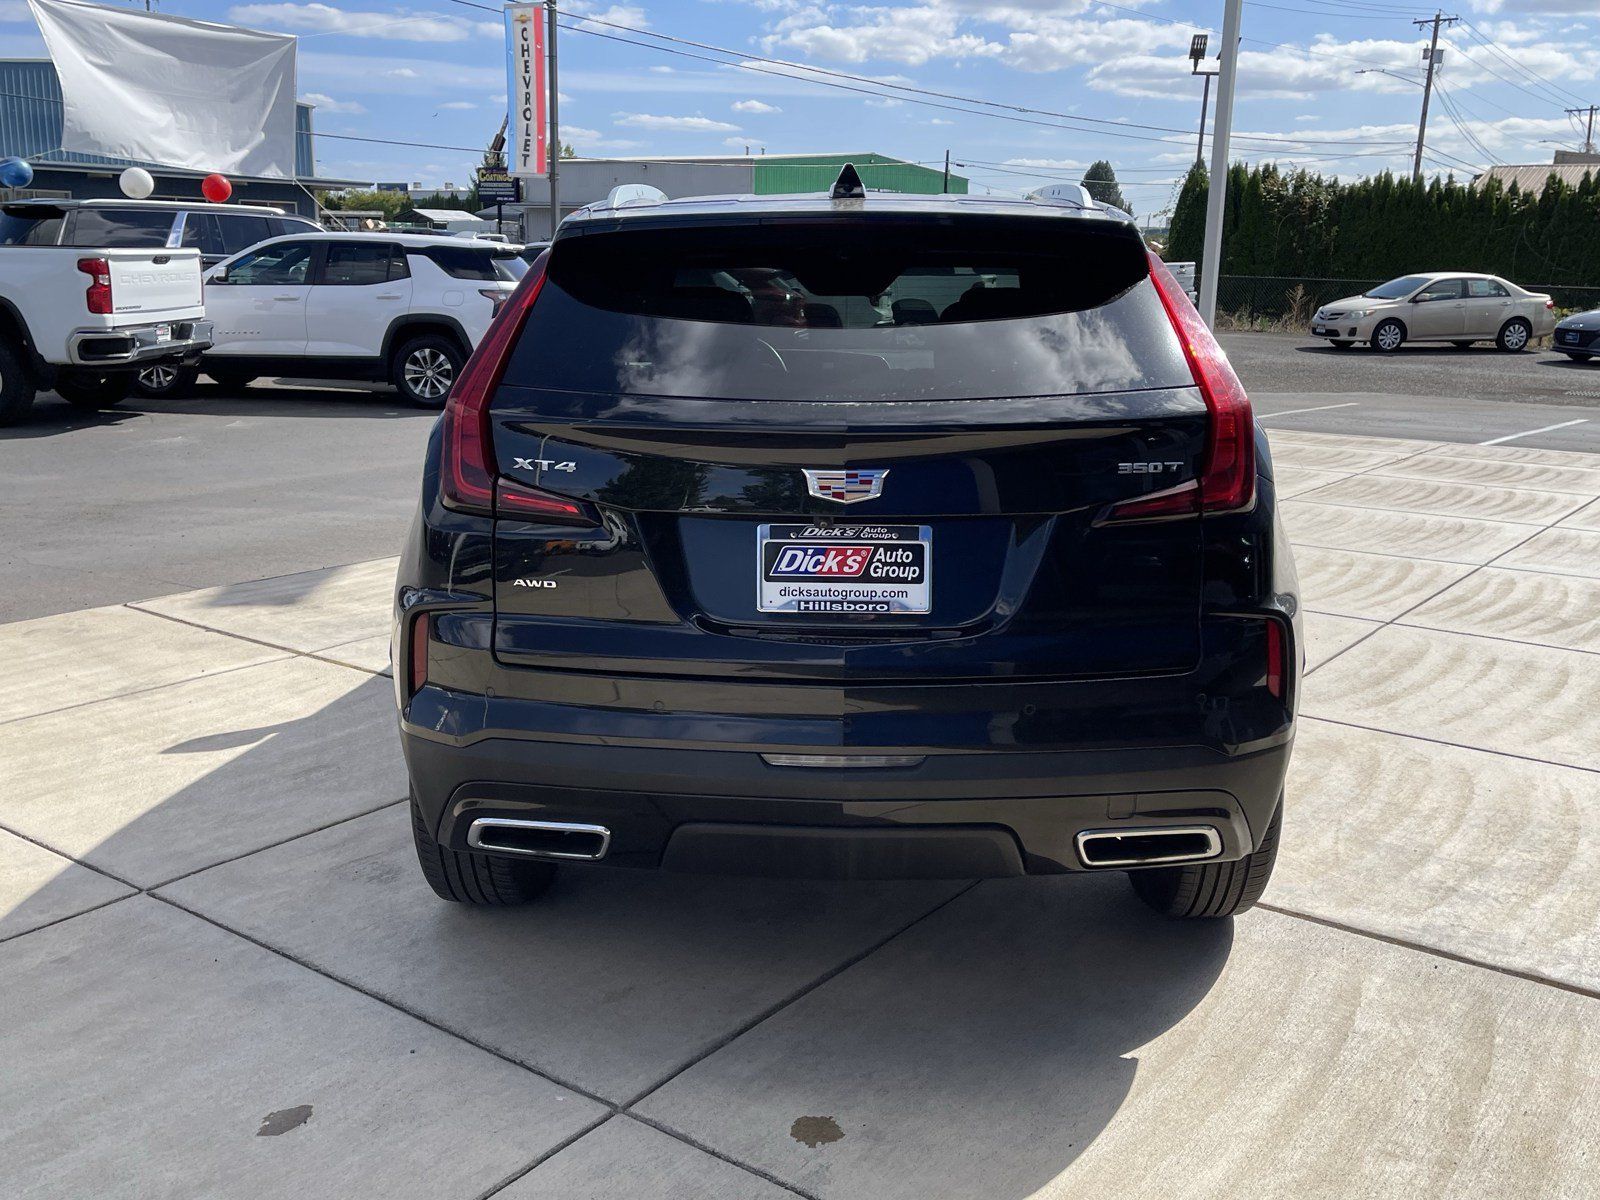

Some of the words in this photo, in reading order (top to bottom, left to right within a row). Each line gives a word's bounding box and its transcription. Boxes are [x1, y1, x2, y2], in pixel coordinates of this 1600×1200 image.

[521, 27, 532, 167] CHEVROLET
[120, 272, 197, 286] CHEVROLET
[513, 457, 577, 473] XT4
[1118, 462, 1184, 474] 350T
[803, 526, 857, 537] Dick's
[860, 532, 892, 540] Group
[780, 549, 862, 573] Dick's
[873, 547, 913, 563] Auto
[870, 562, 920, 581] Group
[513, 578, 557, 589] AWD
[779, 586, 908, 600] dicksautogroup.com
[800, 601, 889, 611] Hillsboro
